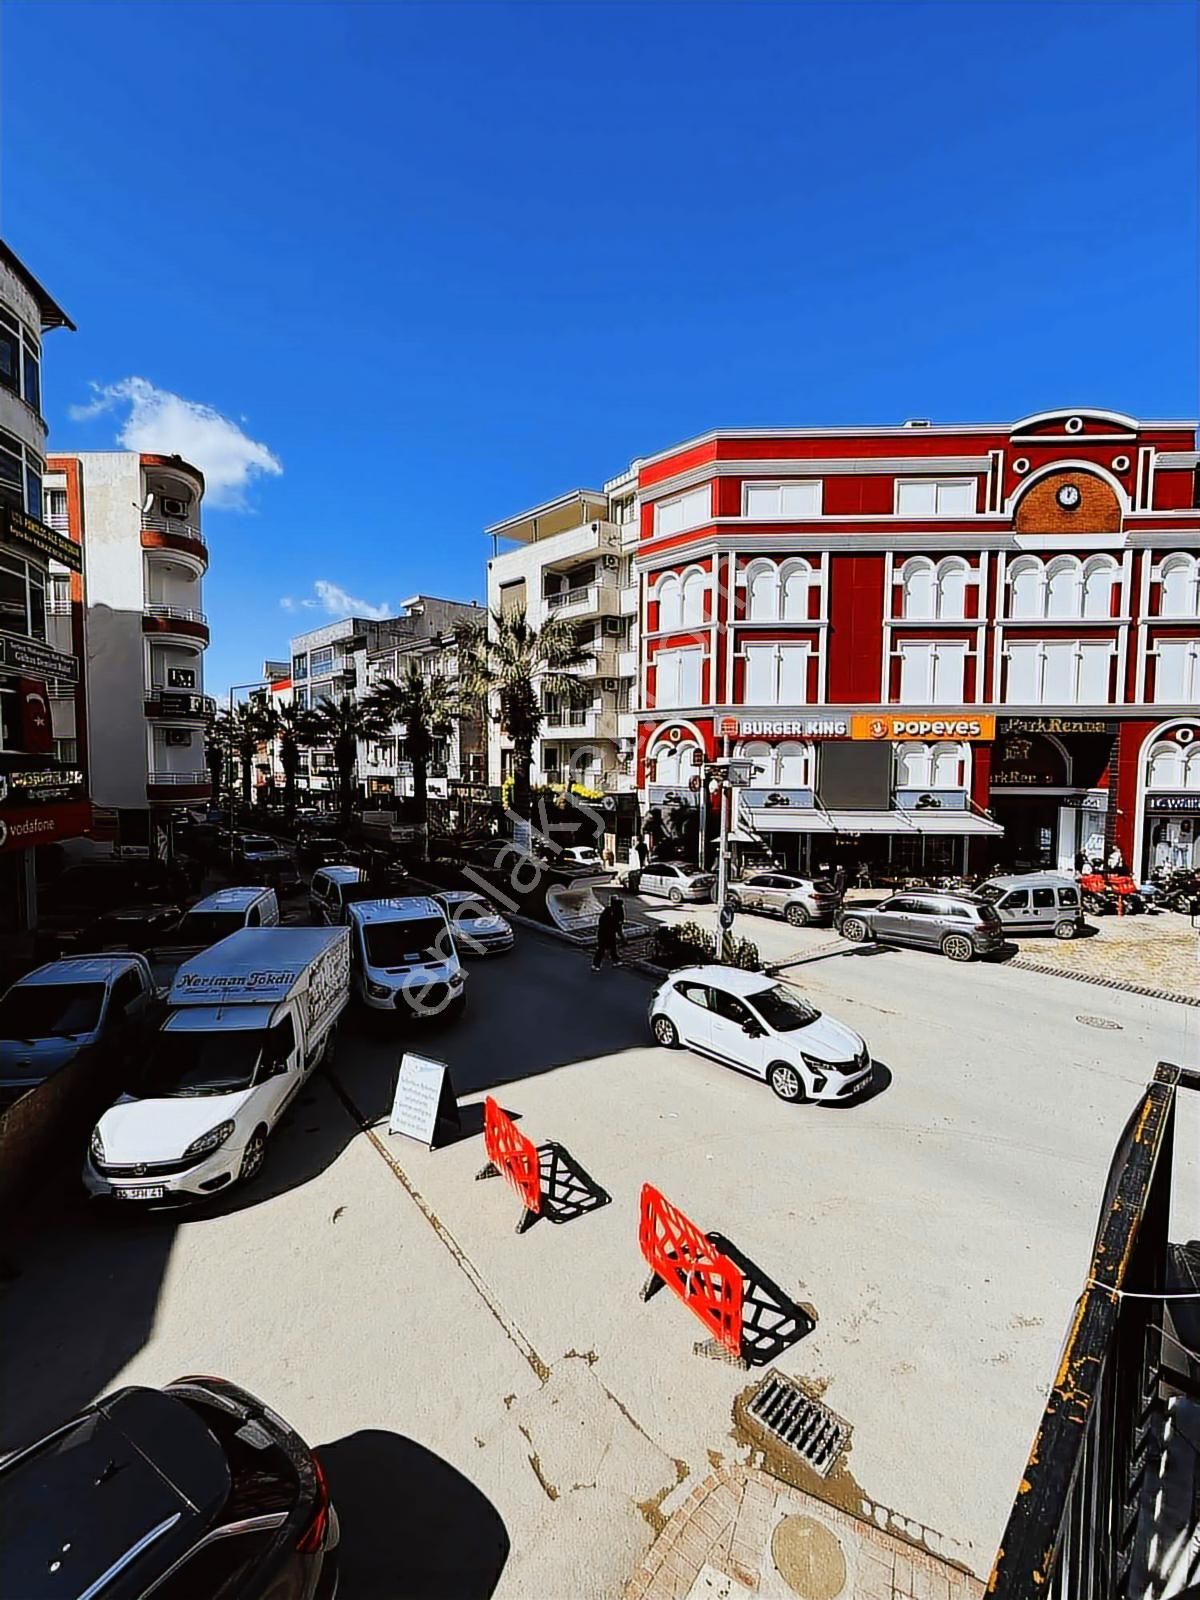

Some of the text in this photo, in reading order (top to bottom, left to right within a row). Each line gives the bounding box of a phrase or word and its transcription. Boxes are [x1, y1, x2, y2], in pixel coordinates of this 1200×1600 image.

[742, 721, 847, 735] BURGER KING
[893, 720, 981, 736] POPEYES
[10, 818, 55, 836] vodafone
